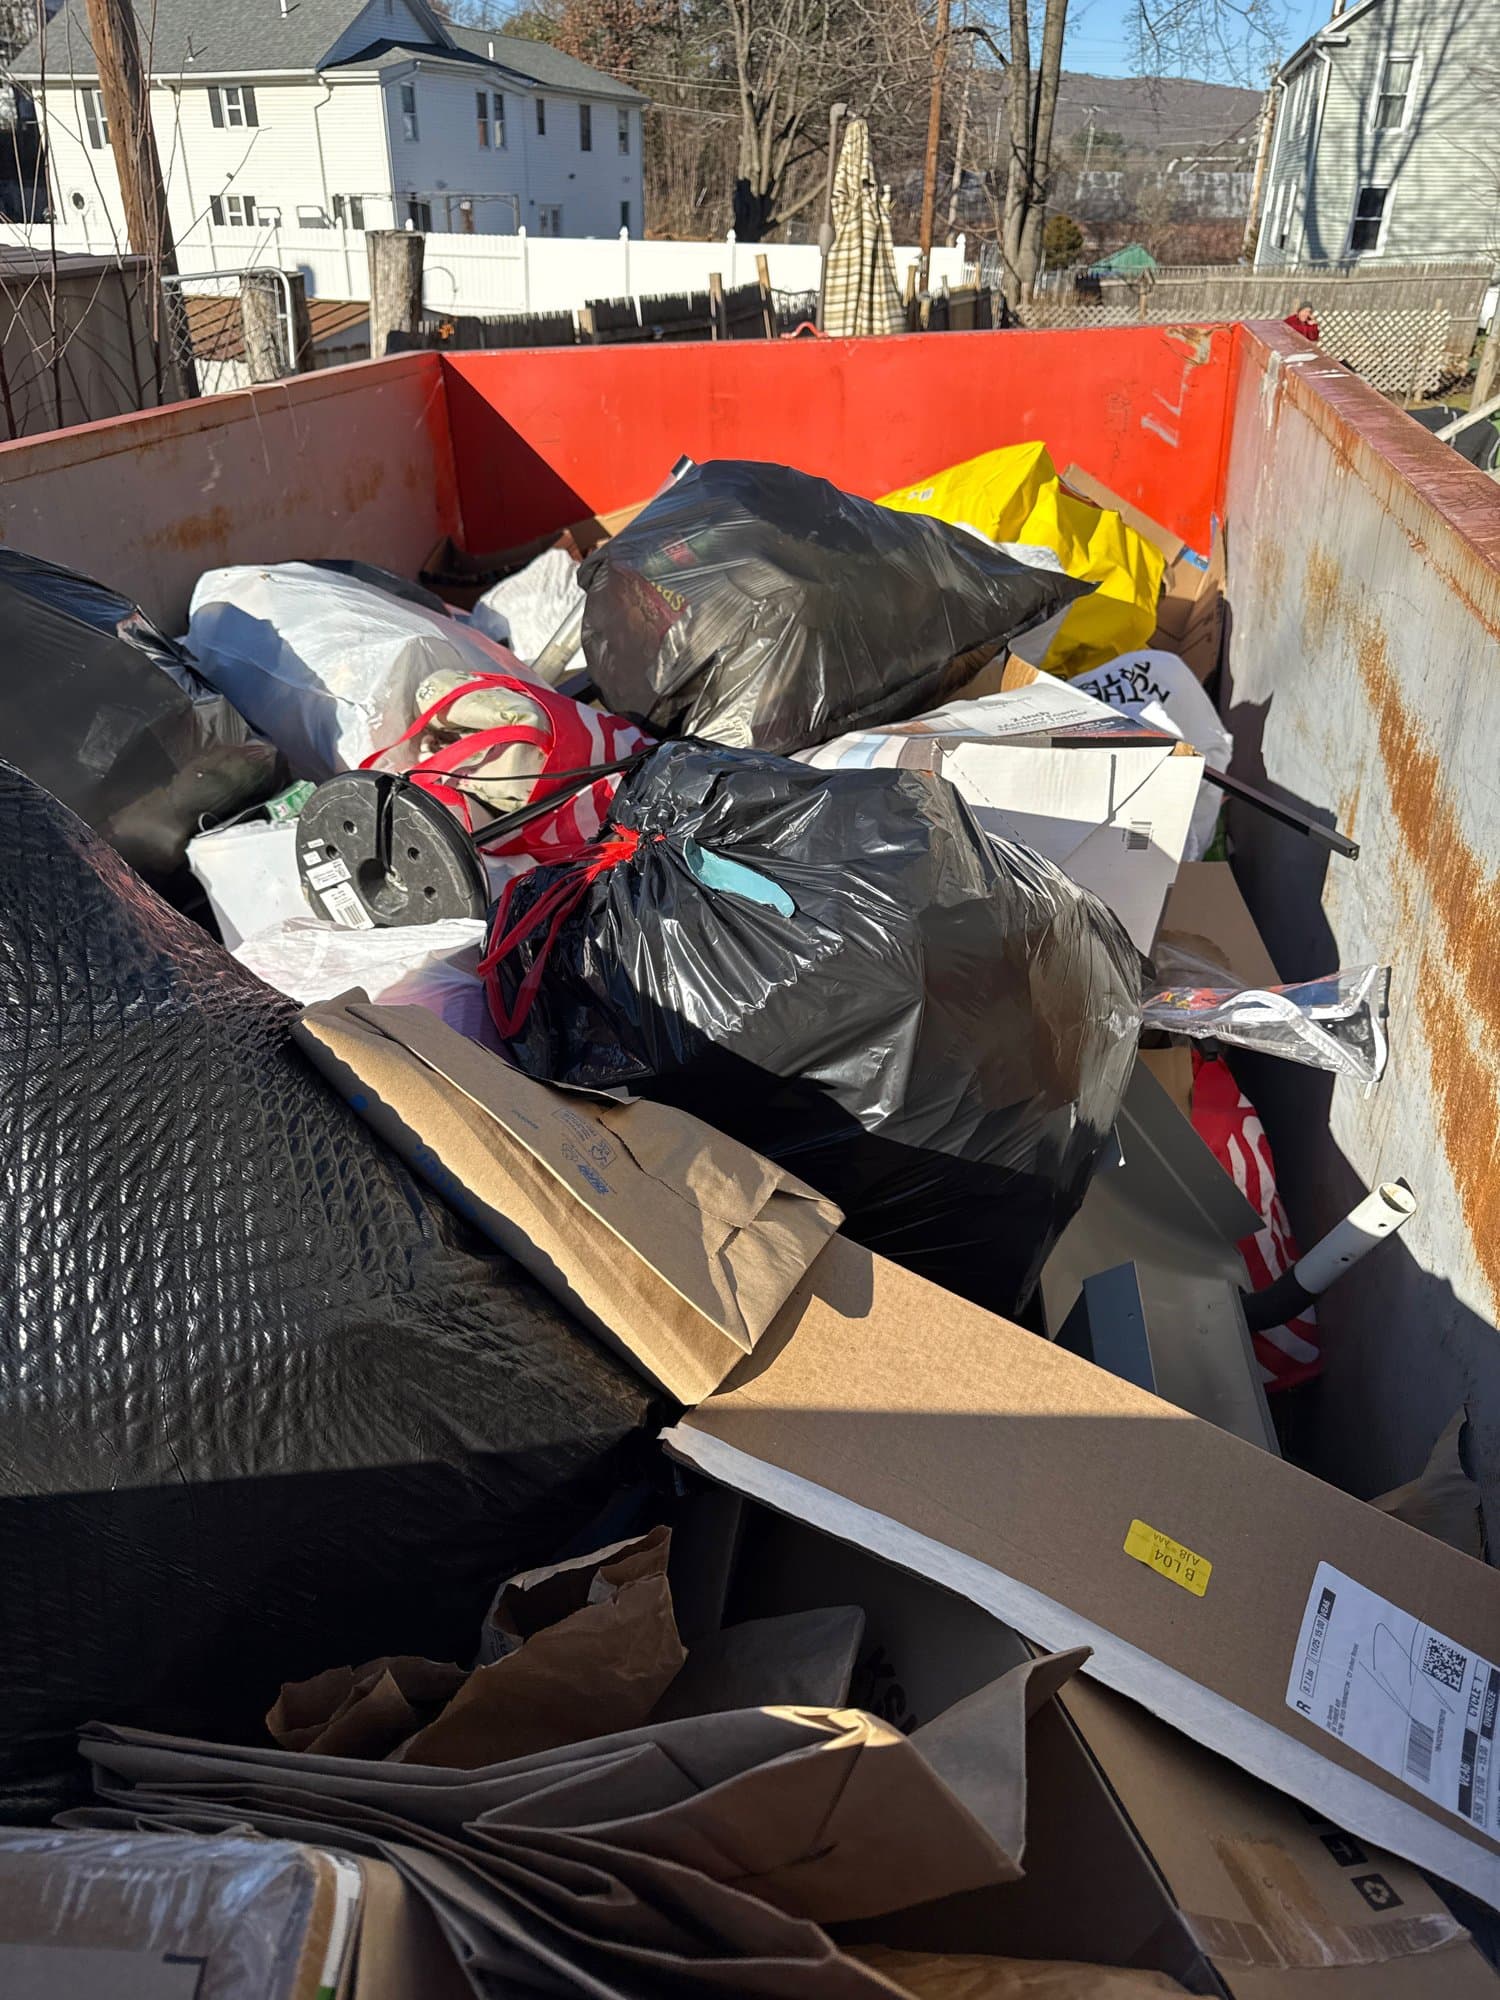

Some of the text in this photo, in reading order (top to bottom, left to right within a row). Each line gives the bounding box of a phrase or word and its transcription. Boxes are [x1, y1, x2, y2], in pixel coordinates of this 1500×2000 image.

[1154, 1549, 1196, 1582] B L04
[1296, 1700, 1311, 1715] R
[1310, 1639, 1320, 1657] 11/25
[1468, 1688, 1482, 1718] CYCLE
[1482, 1690, 1497, 1729] OVERSIZE
